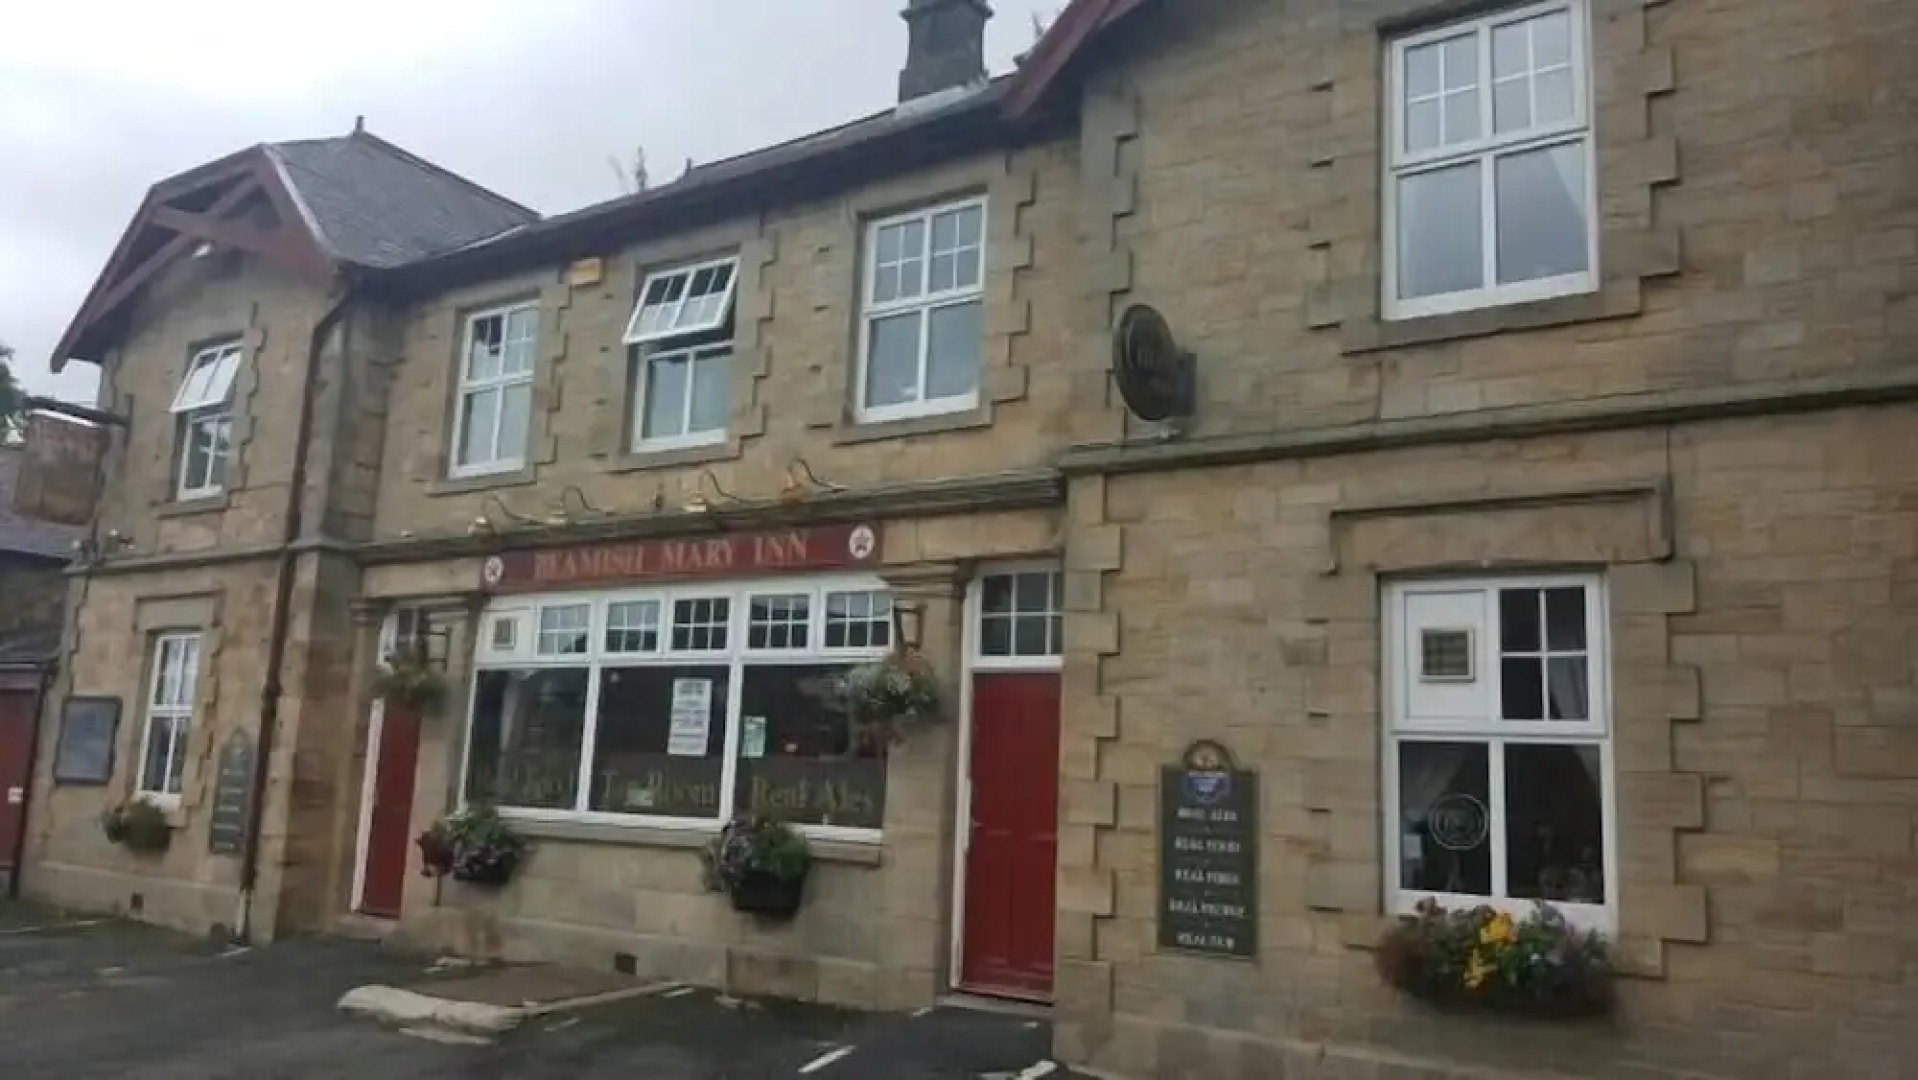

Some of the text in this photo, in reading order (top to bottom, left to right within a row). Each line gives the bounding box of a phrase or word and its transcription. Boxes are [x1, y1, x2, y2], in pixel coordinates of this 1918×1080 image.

[534, 530, 808, 579] BEAMISH MARY INN
